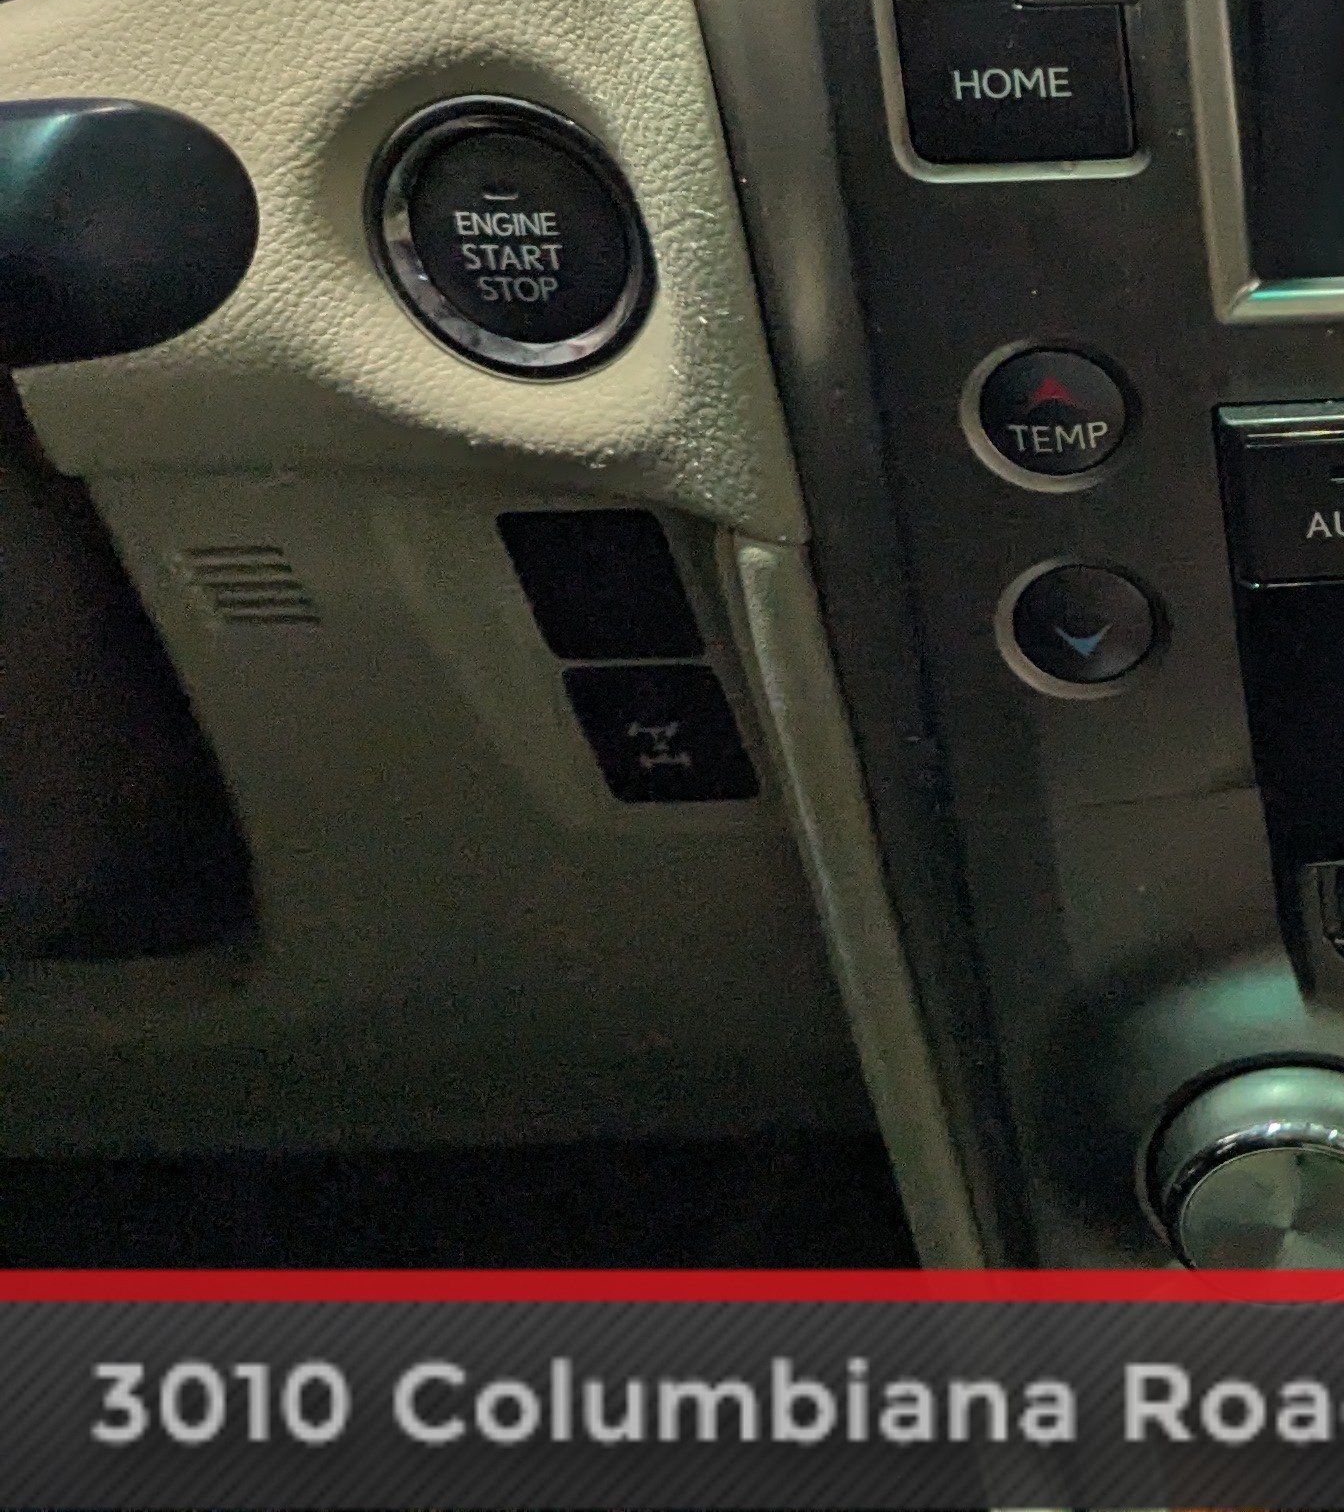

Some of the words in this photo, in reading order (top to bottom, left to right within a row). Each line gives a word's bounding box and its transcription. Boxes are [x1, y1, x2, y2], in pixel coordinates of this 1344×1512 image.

[954, 68, 1073, 100] HOME
[455, 211, 561, 237] ENGINE
[461, 244, 563, 272] START
[477, 277, 559, 303] STOP
[1008, 421, 1109, 454] TEMP
